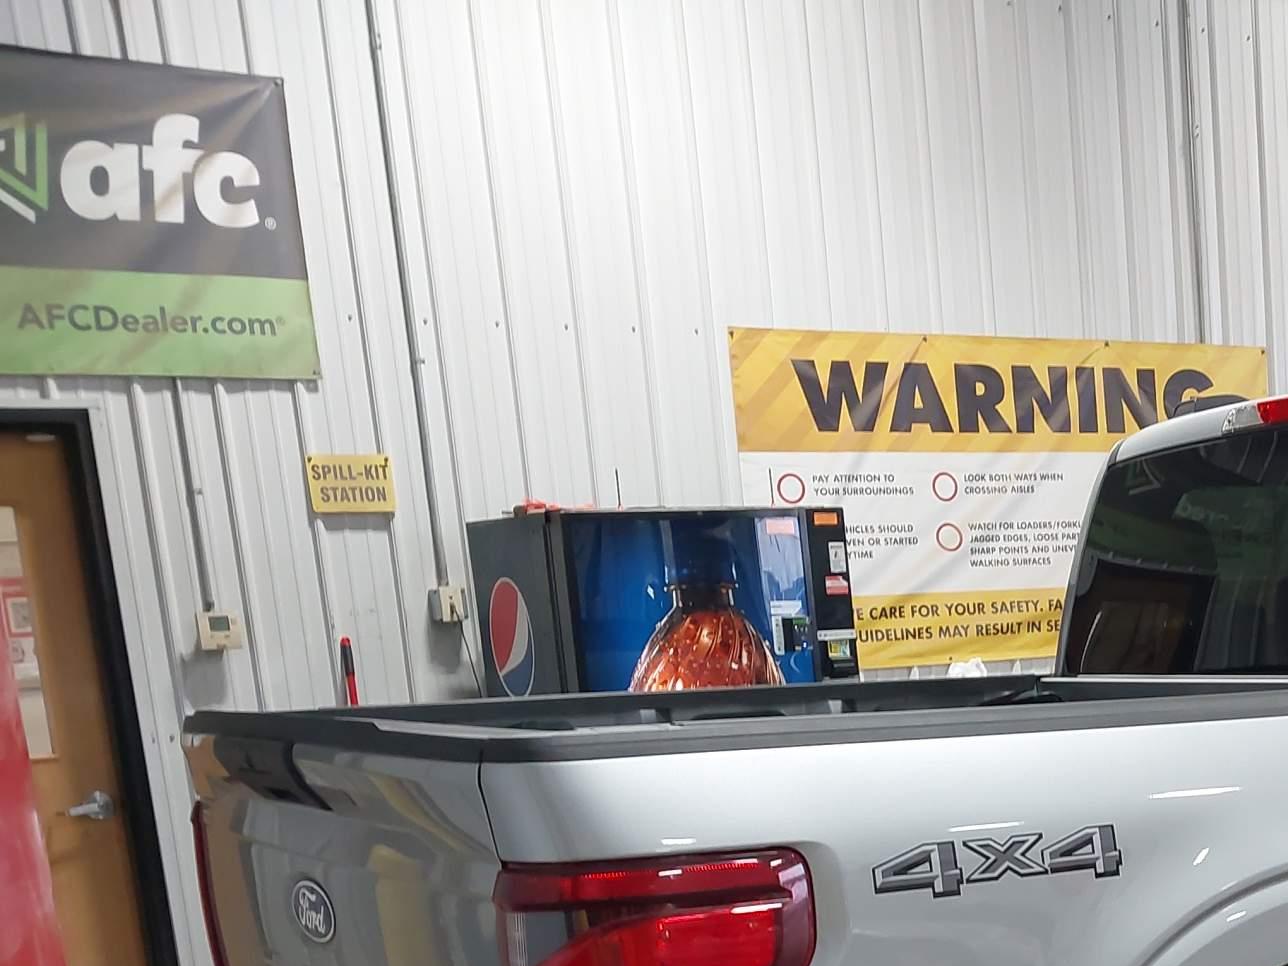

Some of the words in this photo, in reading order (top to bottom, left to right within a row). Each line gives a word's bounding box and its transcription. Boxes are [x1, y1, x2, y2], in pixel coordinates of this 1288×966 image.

[60, 113, 261, 228] afc
[17, 303, 277, 336] AFCDealer.com
[311, 463, 388, 481] SPILL-KIT
[963, 473, 986, 482] LOOK
[989, 473, 1012, 482] BOTH
[1014, 472, 1037, 481] WAYS
[1040, 472, 1064, 481] WHEN
[812, 473, 830, 483] PAY
[833, 473, 881, 483] ATTENTION
[883, 473, 895, 483] TO
[320, 486, 387, 503] STATION
[814, 486, 840, 497] YOUR
[842, 486, 914, 496] SURROUNDINGS
[964, 485, 1008, 495] CROSSING
[1011, 484, 1035, 494] AISLES
[878, 523, 914, 533] SHOULD
[968, 522, 997, 531] WATCH
[999, 521, 1014, 530] FOR
[868, 537, 881, 546] OR
[884, 536, 919, 546] STARTED
[970, 533, 1001, 543] JAGGED
[1003, 533, 1031, 543] EDGES,
[1033, 532, 1060, 542] LOOSE
[970, 546, 996, 556] SHARP
[999, 545, 1029, 555] POINTS
[1032, 545, 1050, 554] AND
[970, 557, 1010, 568] WALKING
[1012, 556, 1052, 567] SURFACES
[869, 604, 906, 620] CARE
[911, 603, 940, 618] FOR
[945, 601, 985, 617] YOUR
[991, 599, 1044, 615] SAFETY.
[939, 624, 970, 638] MAY
[976, 621, 1023, 636] RESULT
[1027, 620, 1042, 633] IN
[298, 887, 326, 935] Ford
